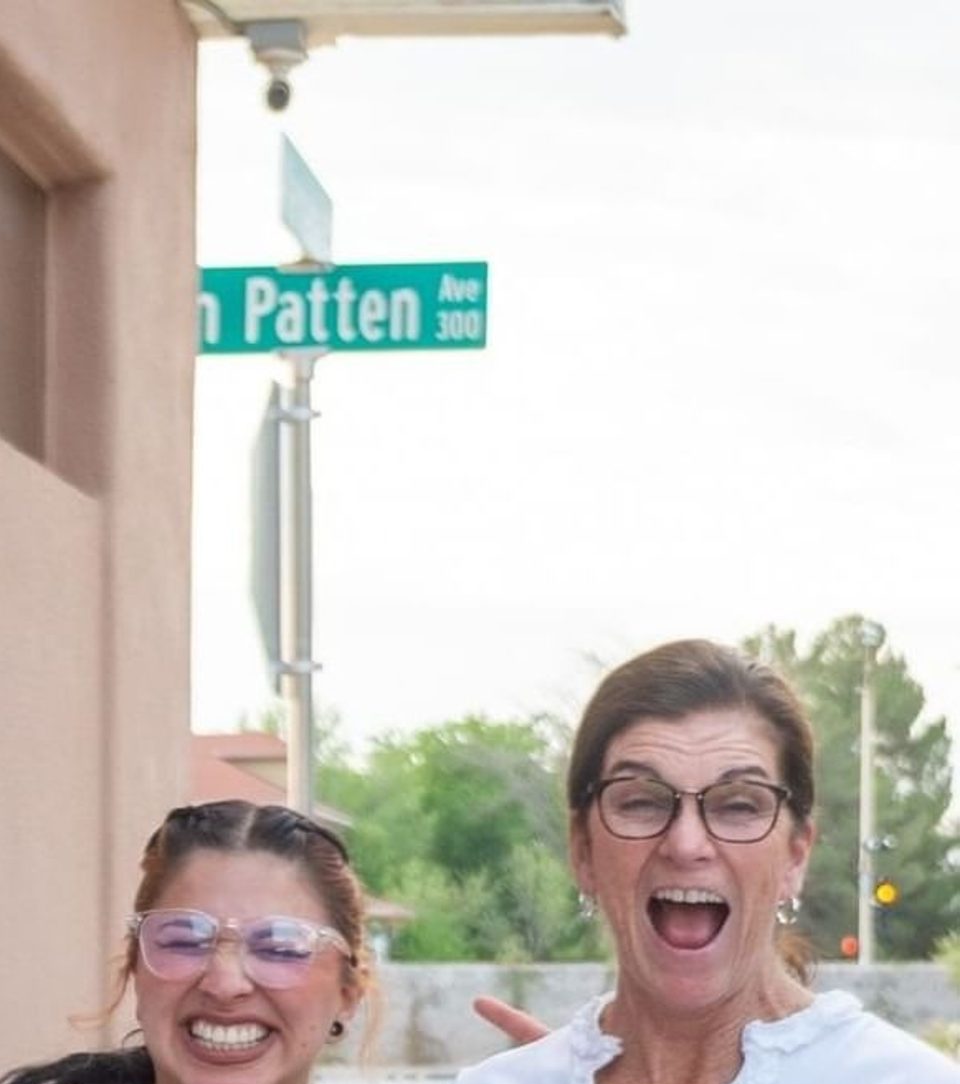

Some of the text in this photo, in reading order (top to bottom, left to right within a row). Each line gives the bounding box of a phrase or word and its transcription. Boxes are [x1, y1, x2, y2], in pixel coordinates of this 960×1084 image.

[439, 274, 479, 301] Ave
[244, 276, 420, 343] Patten
[437, 310, 480, 340] 300
